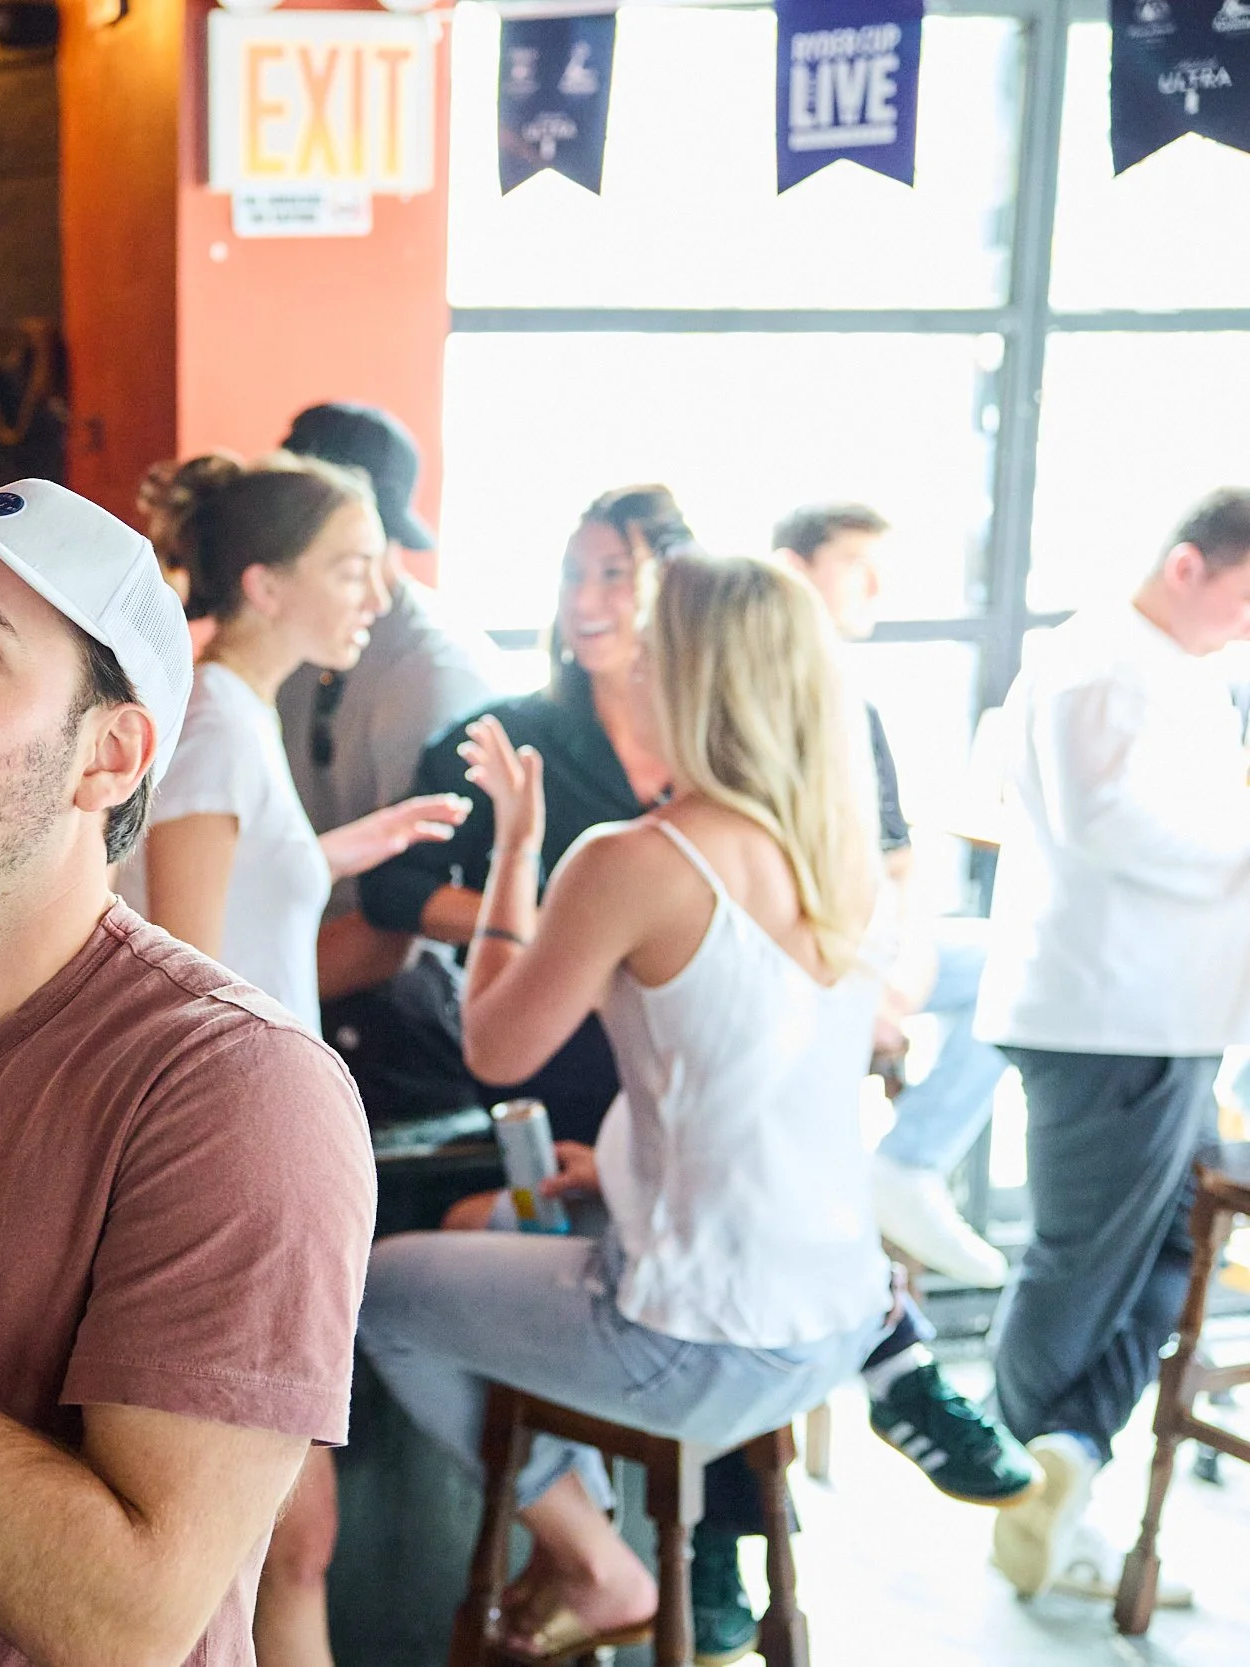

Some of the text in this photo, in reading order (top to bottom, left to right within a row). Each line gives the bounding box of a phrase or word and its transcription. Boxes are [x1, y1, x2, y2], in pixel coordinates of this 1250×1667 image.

[859, 22, 901, 51] CUP
[788, 54, 899, 127] LIVE
[1157, 66, 1233, 94] ULTRA
[244, 44, 411, 176] EXIT
